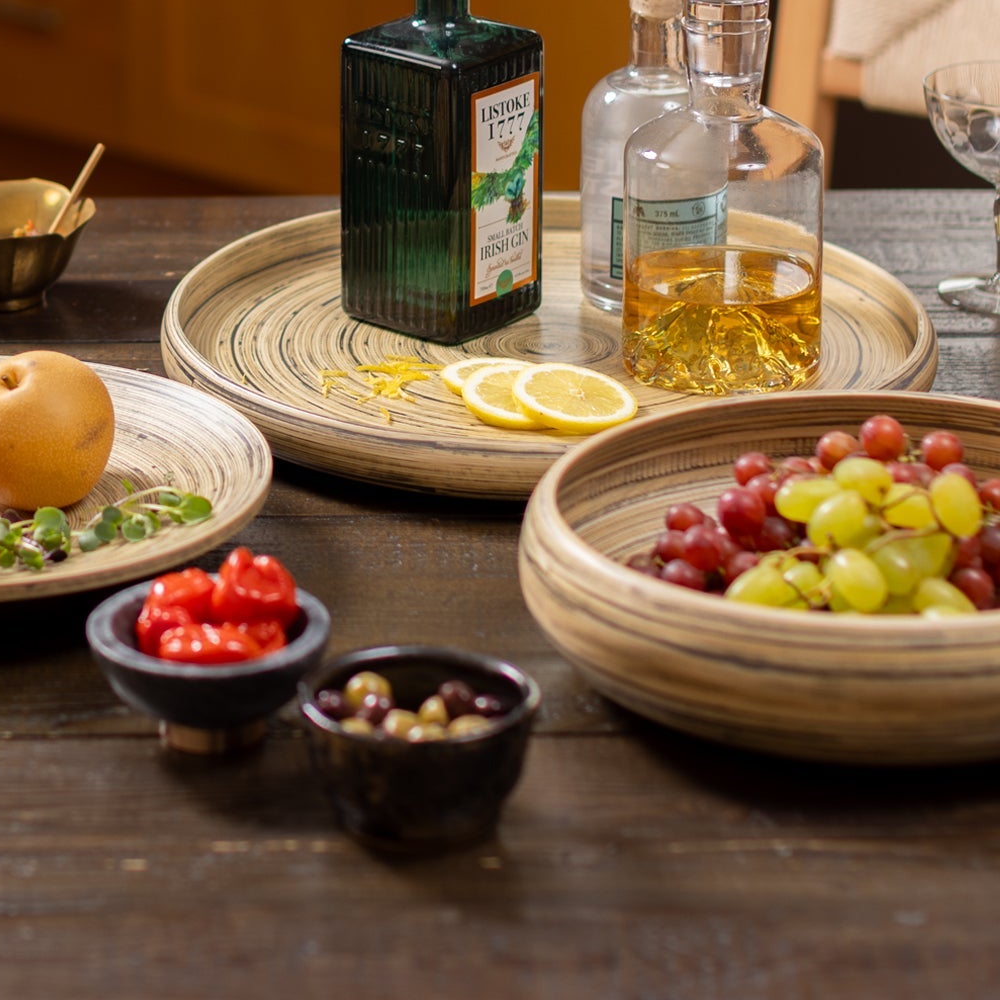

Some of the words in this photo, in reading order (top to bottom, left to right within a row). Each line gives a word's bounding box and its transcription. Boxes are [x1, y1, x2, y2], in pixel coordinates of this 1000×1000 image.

[481, 92, 530, 123] LISTOKE
[488, 111, 525, 141] 1777
[480, 238, 509, 261] IRISH
[511, 228, 529, 249] GIN
[487, 230, 504, 242] SMALL
[506, 222, 523, 236] BATCH
